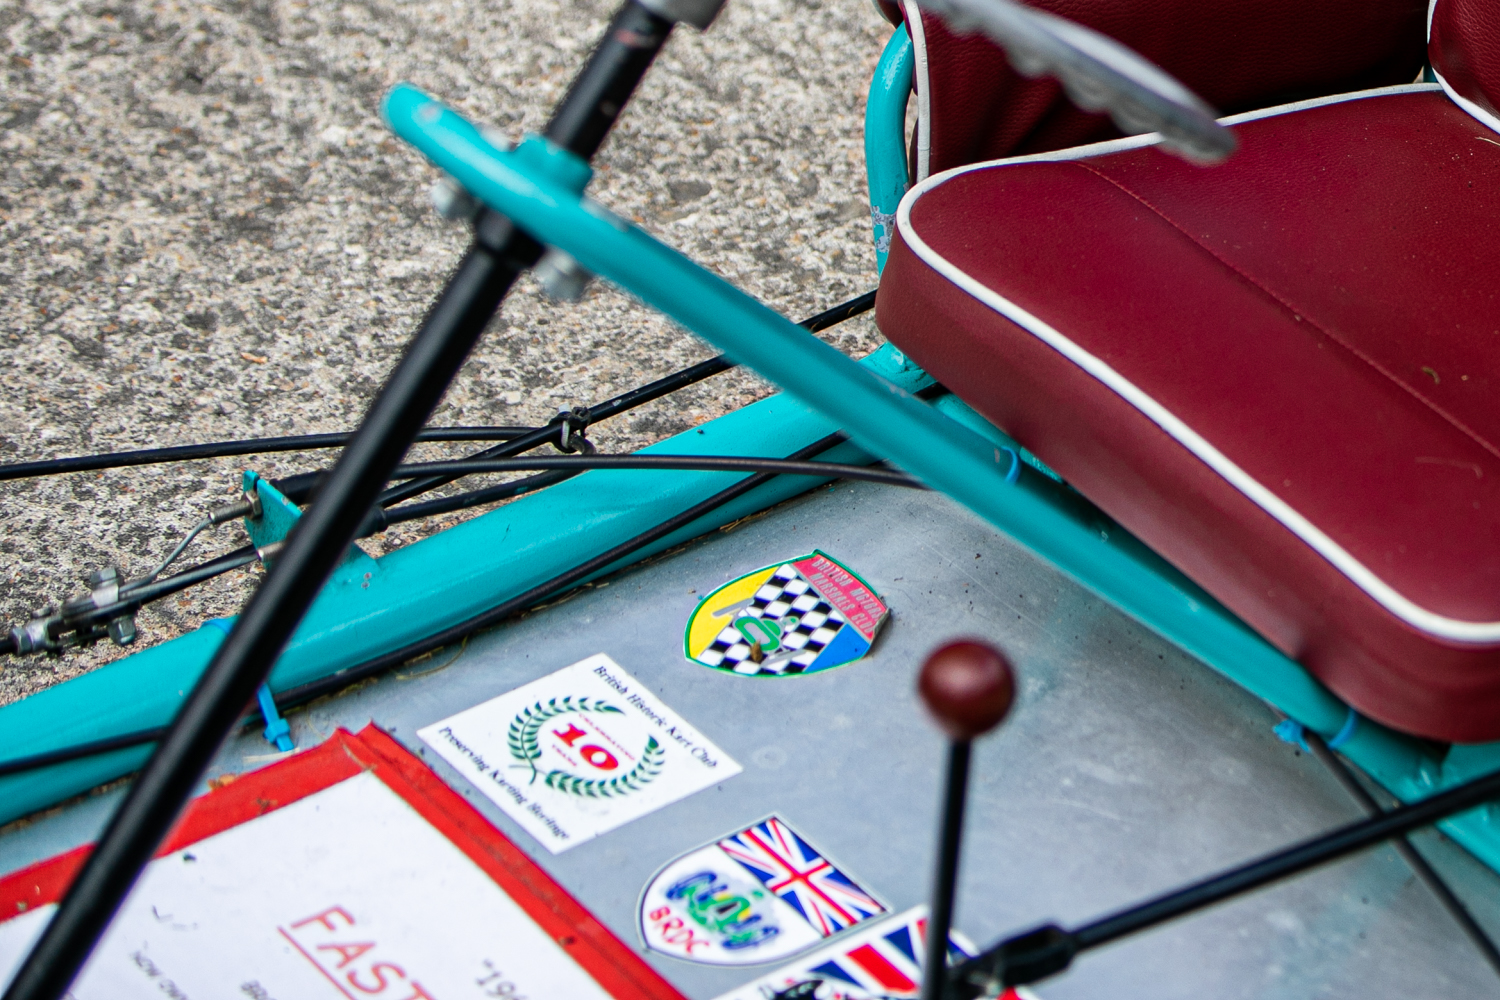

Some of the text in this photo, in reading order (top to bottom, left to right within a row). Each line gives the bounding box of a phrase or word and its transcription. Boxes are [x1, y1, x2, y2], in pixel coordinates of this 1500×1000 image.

[809, 572, 856, 611] MARSHALS
[811, 557, 884, 622] BRITISH MOTORS
[551, 722, 619, 771] 10
[593, 665, 718, 769] British Historic Kart Club
[438, 726, 489, 772] Preserving
[489, 769, 527, 805] Karting
